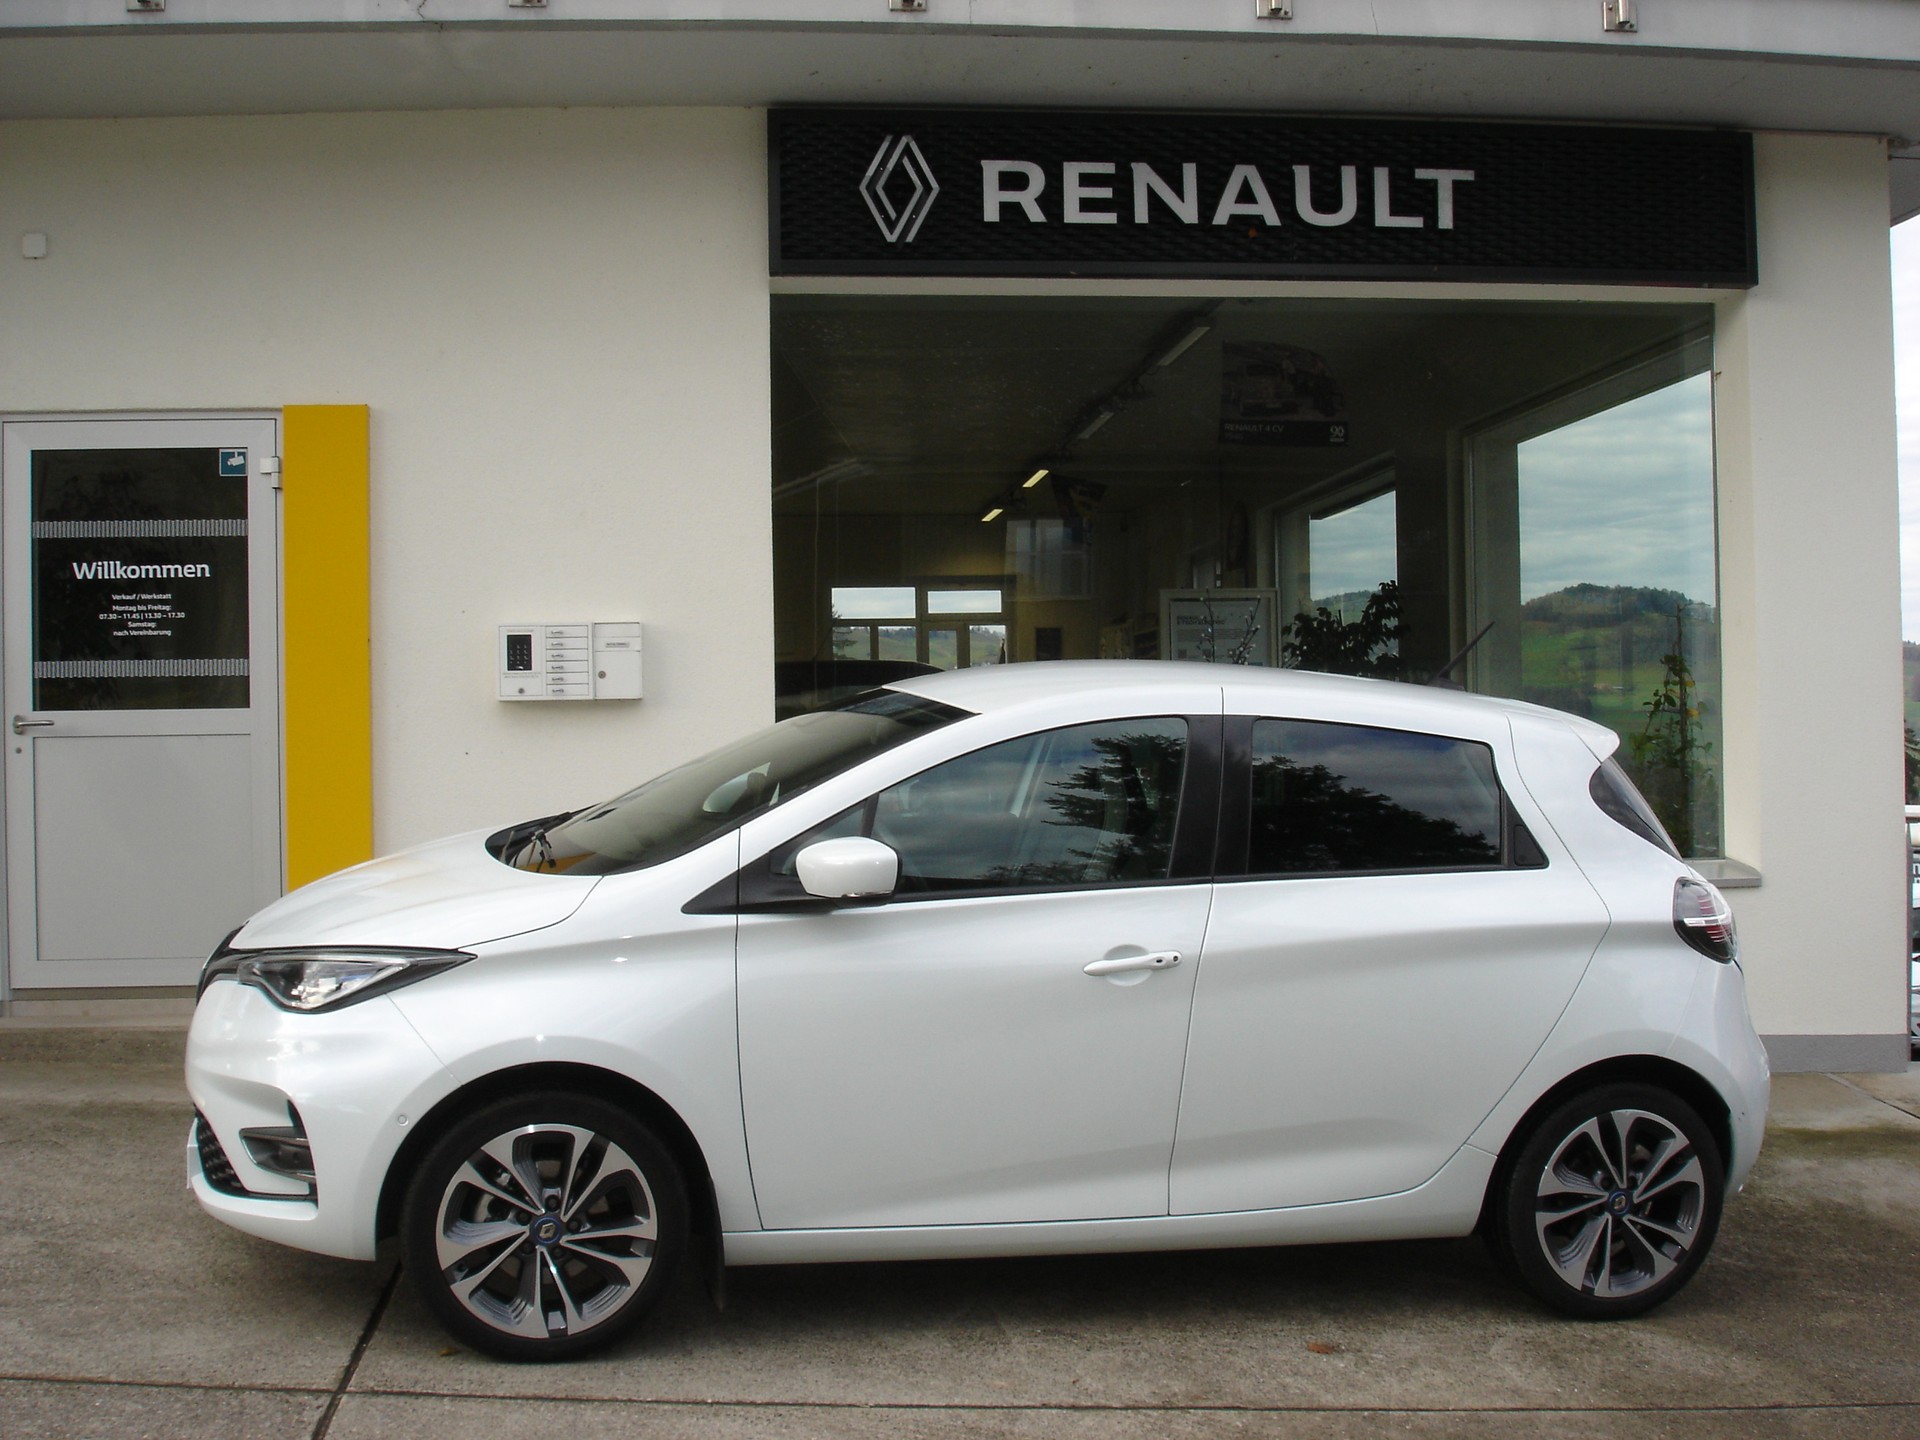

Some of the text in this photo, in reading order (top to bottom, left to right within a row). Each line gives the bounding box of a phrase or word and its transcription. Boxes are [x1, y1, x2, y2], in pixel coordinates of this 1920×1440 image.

[982, 160, 1475, 229] RENAULT
[1224, 424, 1263, 433] RENAULT
[1272, 424, 1285, 433] CV
[72, 561, 211, 580] Willkommen
[112, 593, 137, 601] Verkauf
[112, 604, 137, 612] Montag
[147, 604, 172, 612] Freitag:
[127, 621, 157, 629] Samstag:
[129, 629, 172, 637] Vereinbarung
